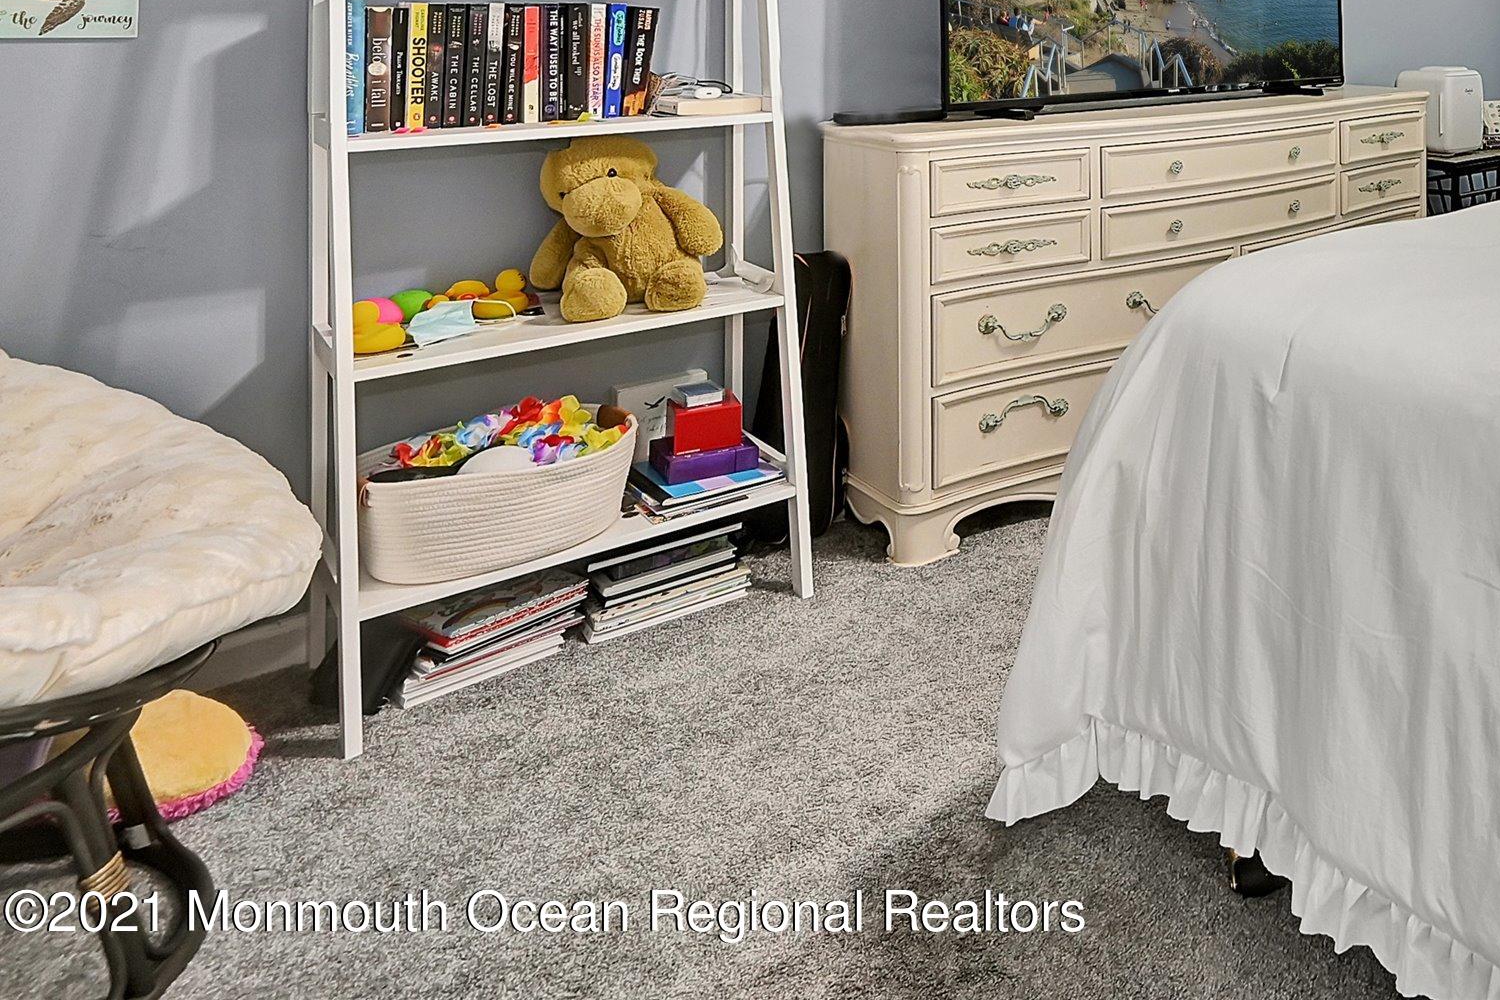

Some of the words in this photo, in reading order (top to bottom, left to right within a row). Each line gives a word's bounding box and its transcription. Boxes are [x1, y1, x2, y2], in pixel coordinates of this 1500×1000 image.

[11, 10, 37, 30] the
[77, 14, 133, 30] journey
[549, 9, 558, 26] THE
[593, 18, 602, 32] THE
[637, 9, 645, 30] ZUSAK
[549, 28, 558, 46] WAY
[572, 31, 580, 40] all
[593, 33, 601, 48] SUN
[636, 33, 646, 47] THE
[371, 37, 388, 74] befo
[509, 52, 517, 67] YOU
[571, 41, 580, 65] looked
[634, 48, 645, 66] BOOK
[410, 37, 426, 105] SHOOTER
[450, 54, 459, 74] THE
[471, 56, 480, 74] THE
[488, 60, 498, 80] THE
[549, 53, 558, 76] USED
[592, 57, 601, 76] ALSO
[508, 67, 516, 83] WILL
[549, 77, 558, 89] TO
[430, 71, 439, 102] AWAKE
[448, 78, 458, 109] CABIN
[469, 77, 479, 113] CELLAR
[487, 82, 497, 108] LOST
[508, 84, 516, 94] BE
[591, 83, 601, 101] STAR
[371, 87, 388, 108] fall
[507, 94, 515, 111] MINE
[549, 91, 558, 102] BE
